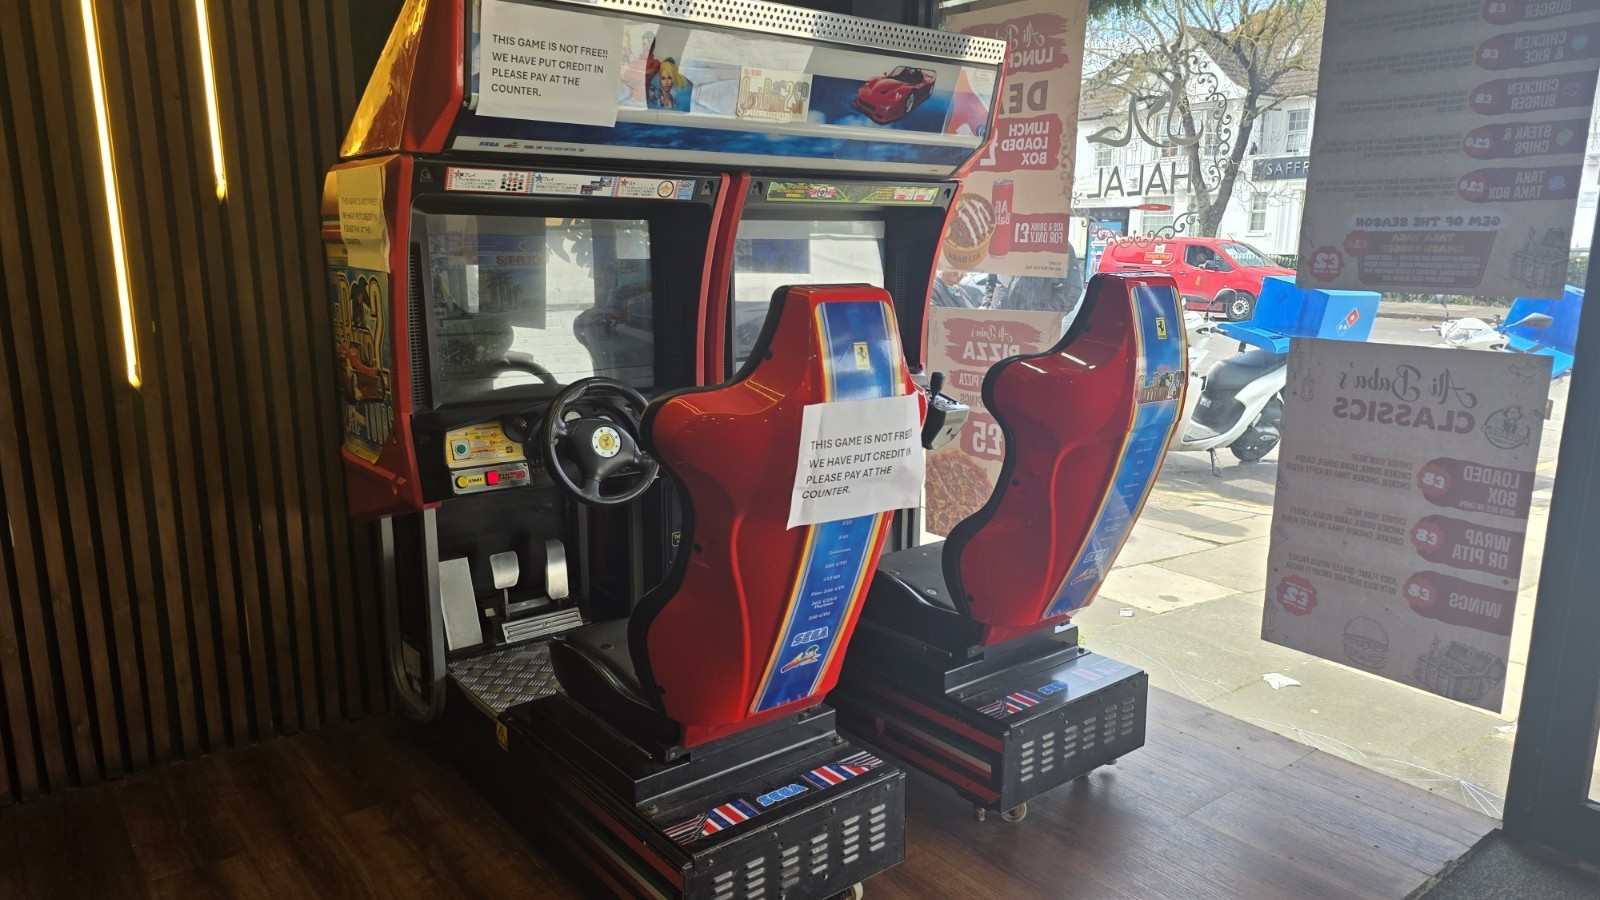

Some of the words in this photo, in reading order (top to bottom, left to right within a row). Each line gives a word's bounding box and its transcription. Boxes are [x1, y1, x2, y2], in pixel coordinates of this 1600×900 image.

[492, 34, 516, 46] THIS
[518, 38, 545, 50] GAME
[548, 42, 557, 51] IS
[560, 44, 578, 54] NOT
[580, 46, 608, 58] FREE!!
[492, 52, 508, 62] WE
[511, 54, 536, 66] HAVE
[539, 58, 557, 68] PUT
[559, 61, 592, 72] CREDIT
[594, 66, 604, 74] IN
[492, 68, 527, 80] PLEASE
[531, 72, 548, 82] PAY
[550, 74, 560, 83] AT
[563, 76, 580, 86] THE
[491, 84, 542, 97] COUNTER.
[811, 440, 832, 450] THIS
[835, 436, 862, 447] GAME
[864, 436, 872, 444] IS
[875, 433, 893, 443] NOT
[809, 458, 825, 468] WE
[827, 456, 851, 467] HAVE
[854, 453, 871, 463] PUT
[873, 449, 905, 460] CREDIT
[806, 472, 842, 484] PLEASE
[845, 470, 861, 480] PAY
[862, 468, 874, 478] AT
[876, 466, 892, 475] THE
[802, 486, 851, 499] COUNTER.
[791, 626, 829, 647] SEGA
[756, 783, 809, 806] SEGA
